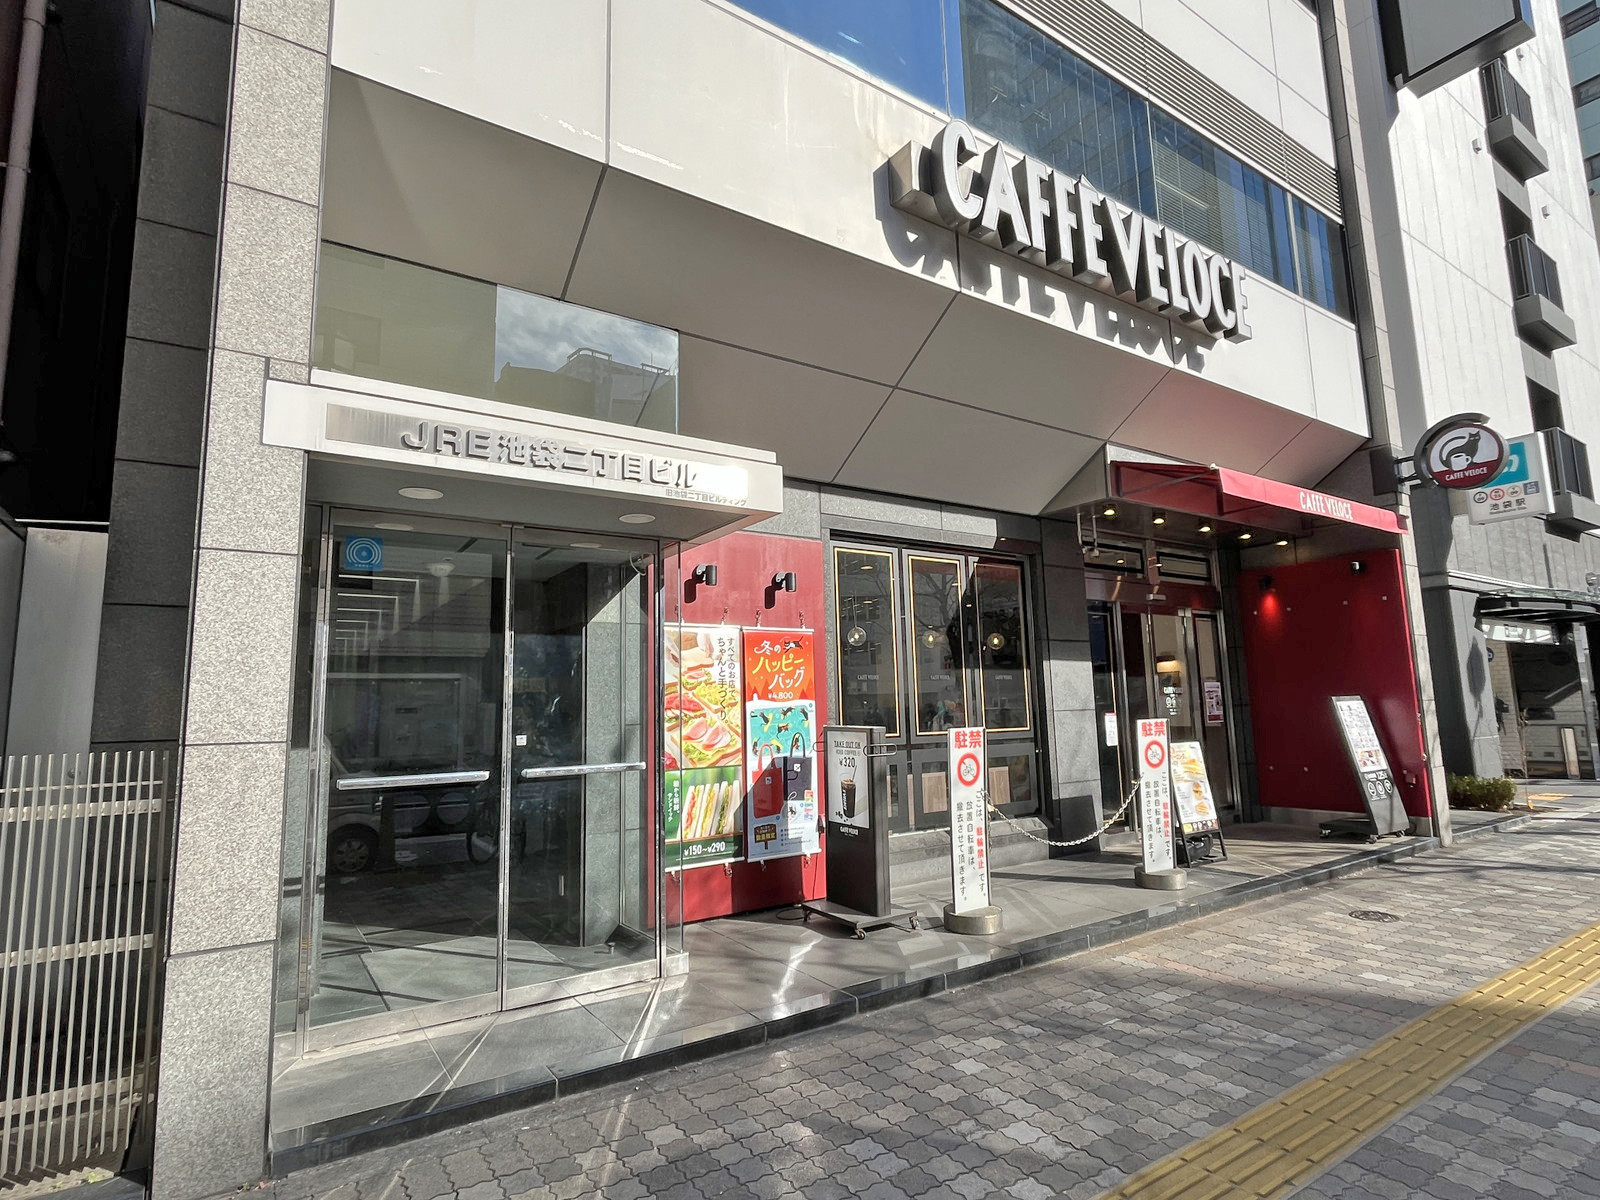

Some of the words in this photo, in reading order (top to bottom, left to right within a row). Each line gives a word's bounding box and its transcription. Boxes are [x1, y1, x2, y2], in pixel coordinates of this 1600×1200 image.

[1103, 196, 1252, 341] VELOCE
[400, 421, 698, 489] JRE池袋二丁目ビル
[1464, 466, 1488, 477] VELOCE
[1324, 497, 1354, 521] VELOCE
[1489, 497, 1527, 511] 池袋駅
[753, 640, 782, 655] 冬の
[752, 653, 804, 675] ハッピー
[768, 666, 805, 690] バッグ
[1141, 721, 1166, 736] 駐禁
[954, 730, 982, 749] 駐禁
[838, 756, 856, 768] ¥320
